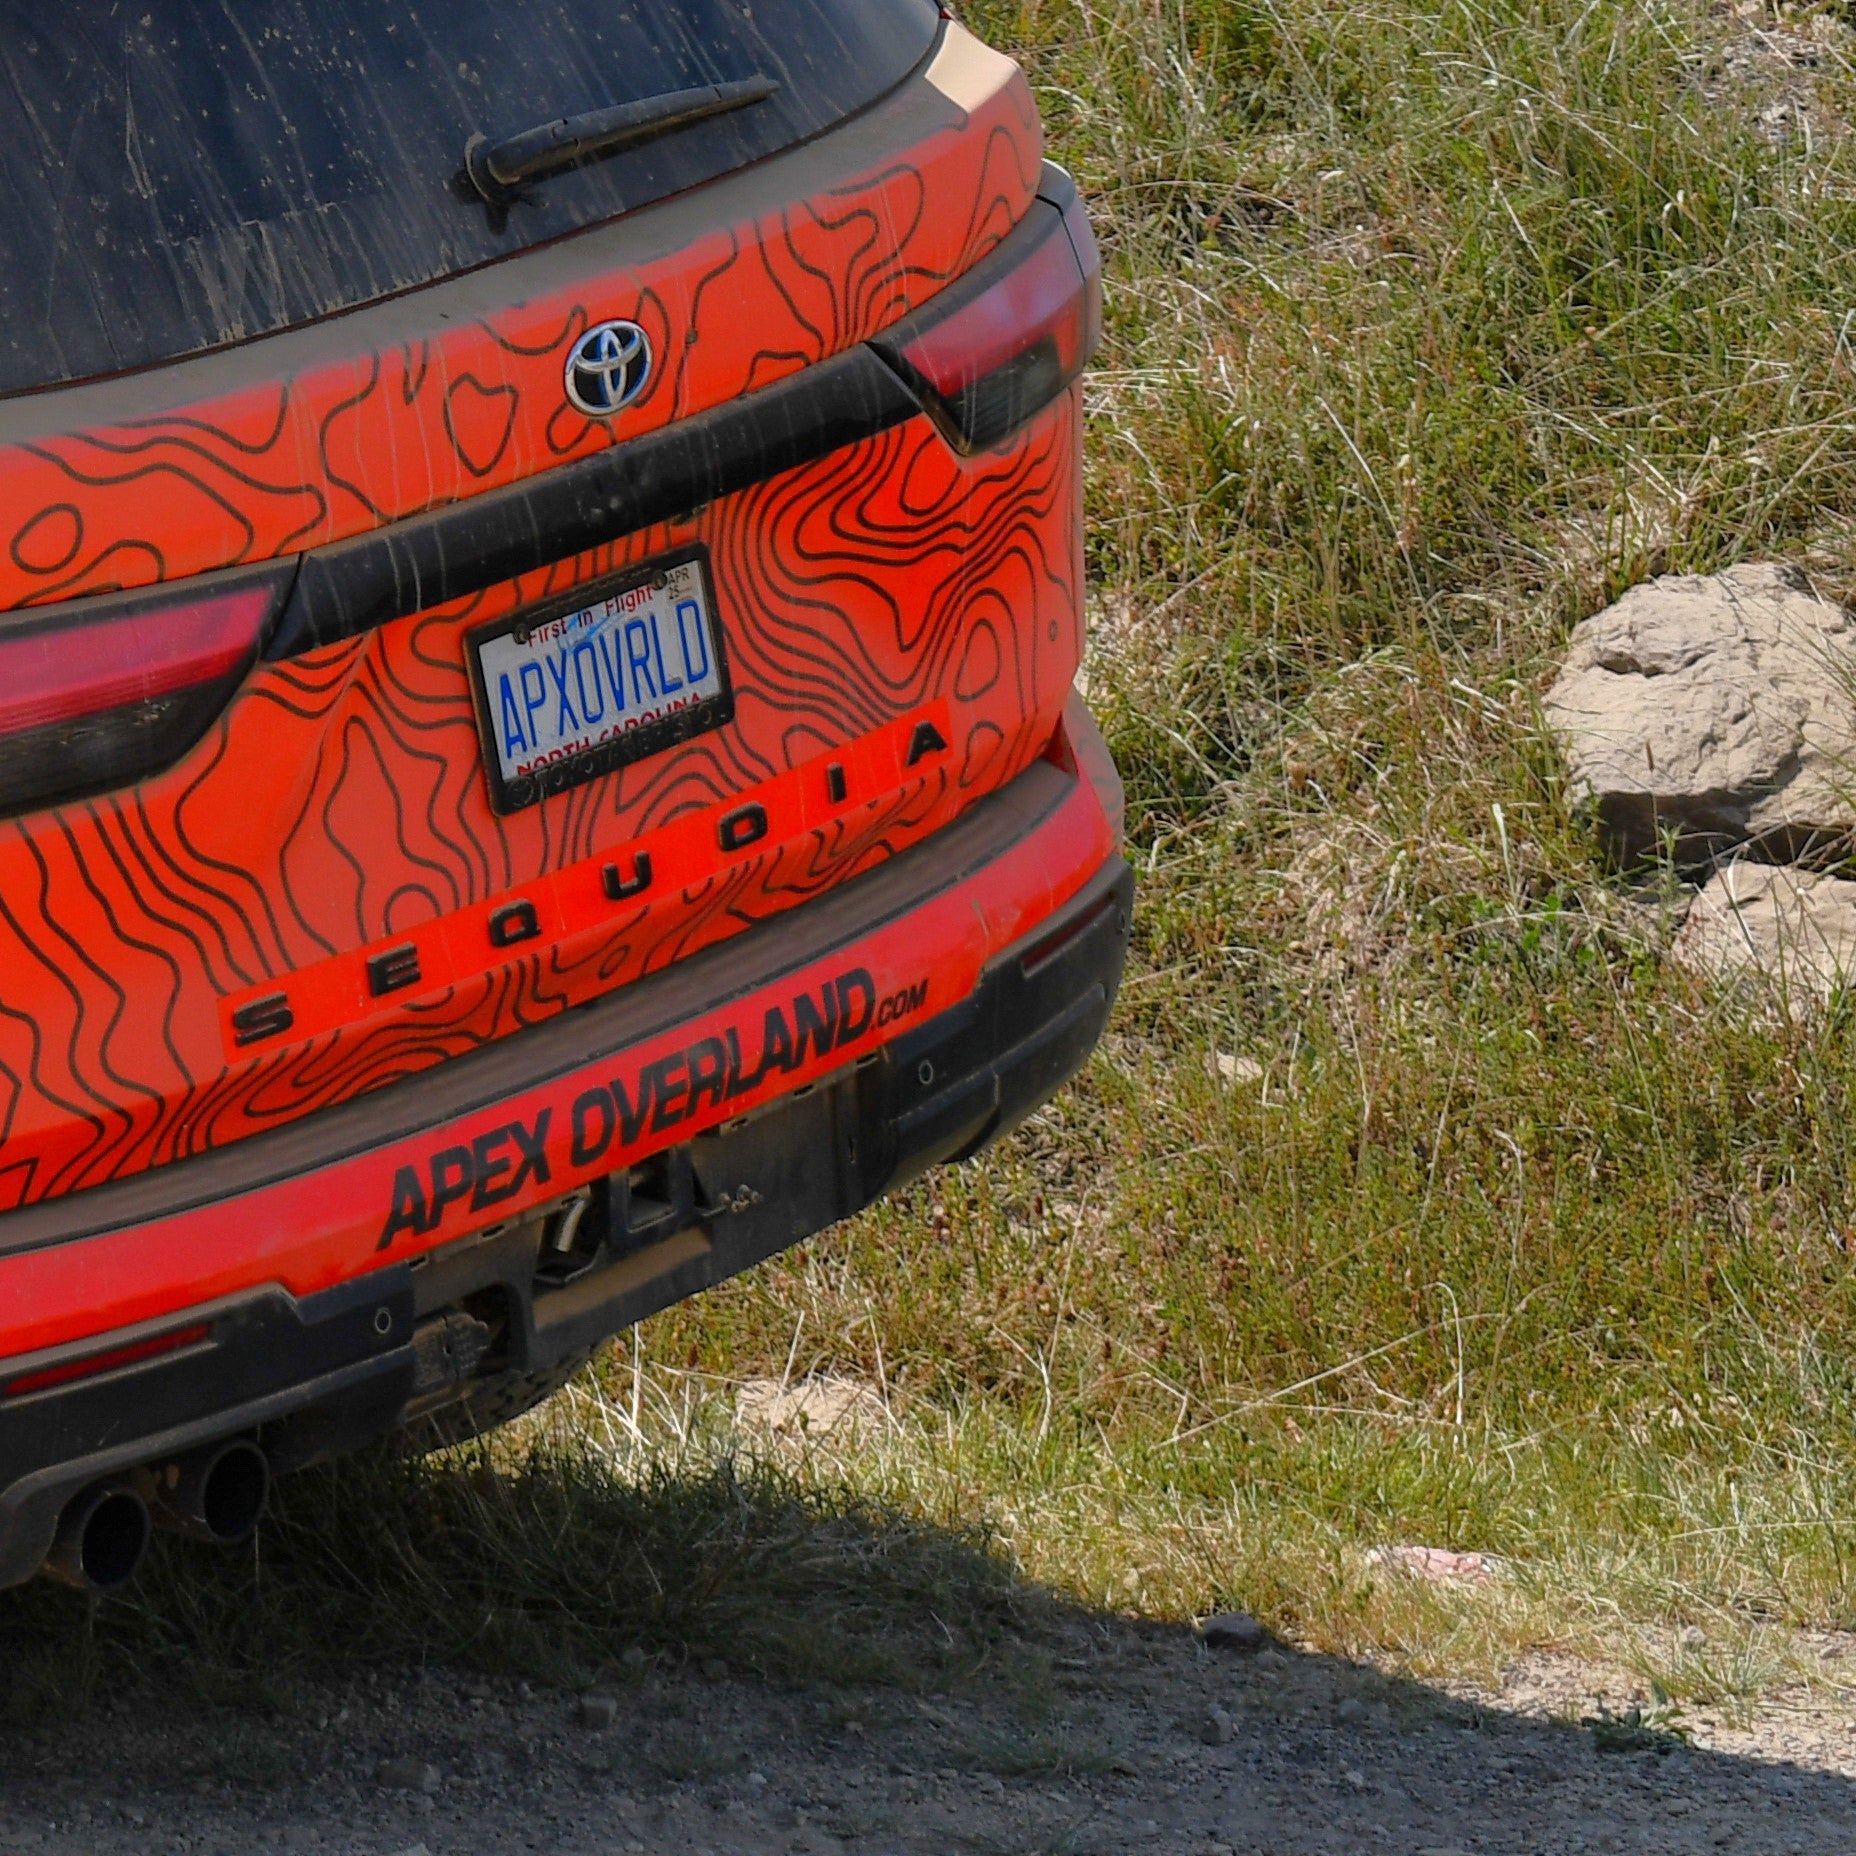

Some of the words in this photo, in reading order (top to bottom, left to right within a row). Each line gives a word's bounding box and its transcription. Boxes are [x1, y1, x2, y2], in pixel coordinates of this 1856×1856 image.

[527, 618, 569, 648] First
[604, 586, 654, 617] Flight
[667, 567, 690, 584] APR
[499, 599, 709, 759] APXOVRLD
[231, 720, 948, 1046] SEQUOIA
[376, 1108, 552, 1252] APEX
